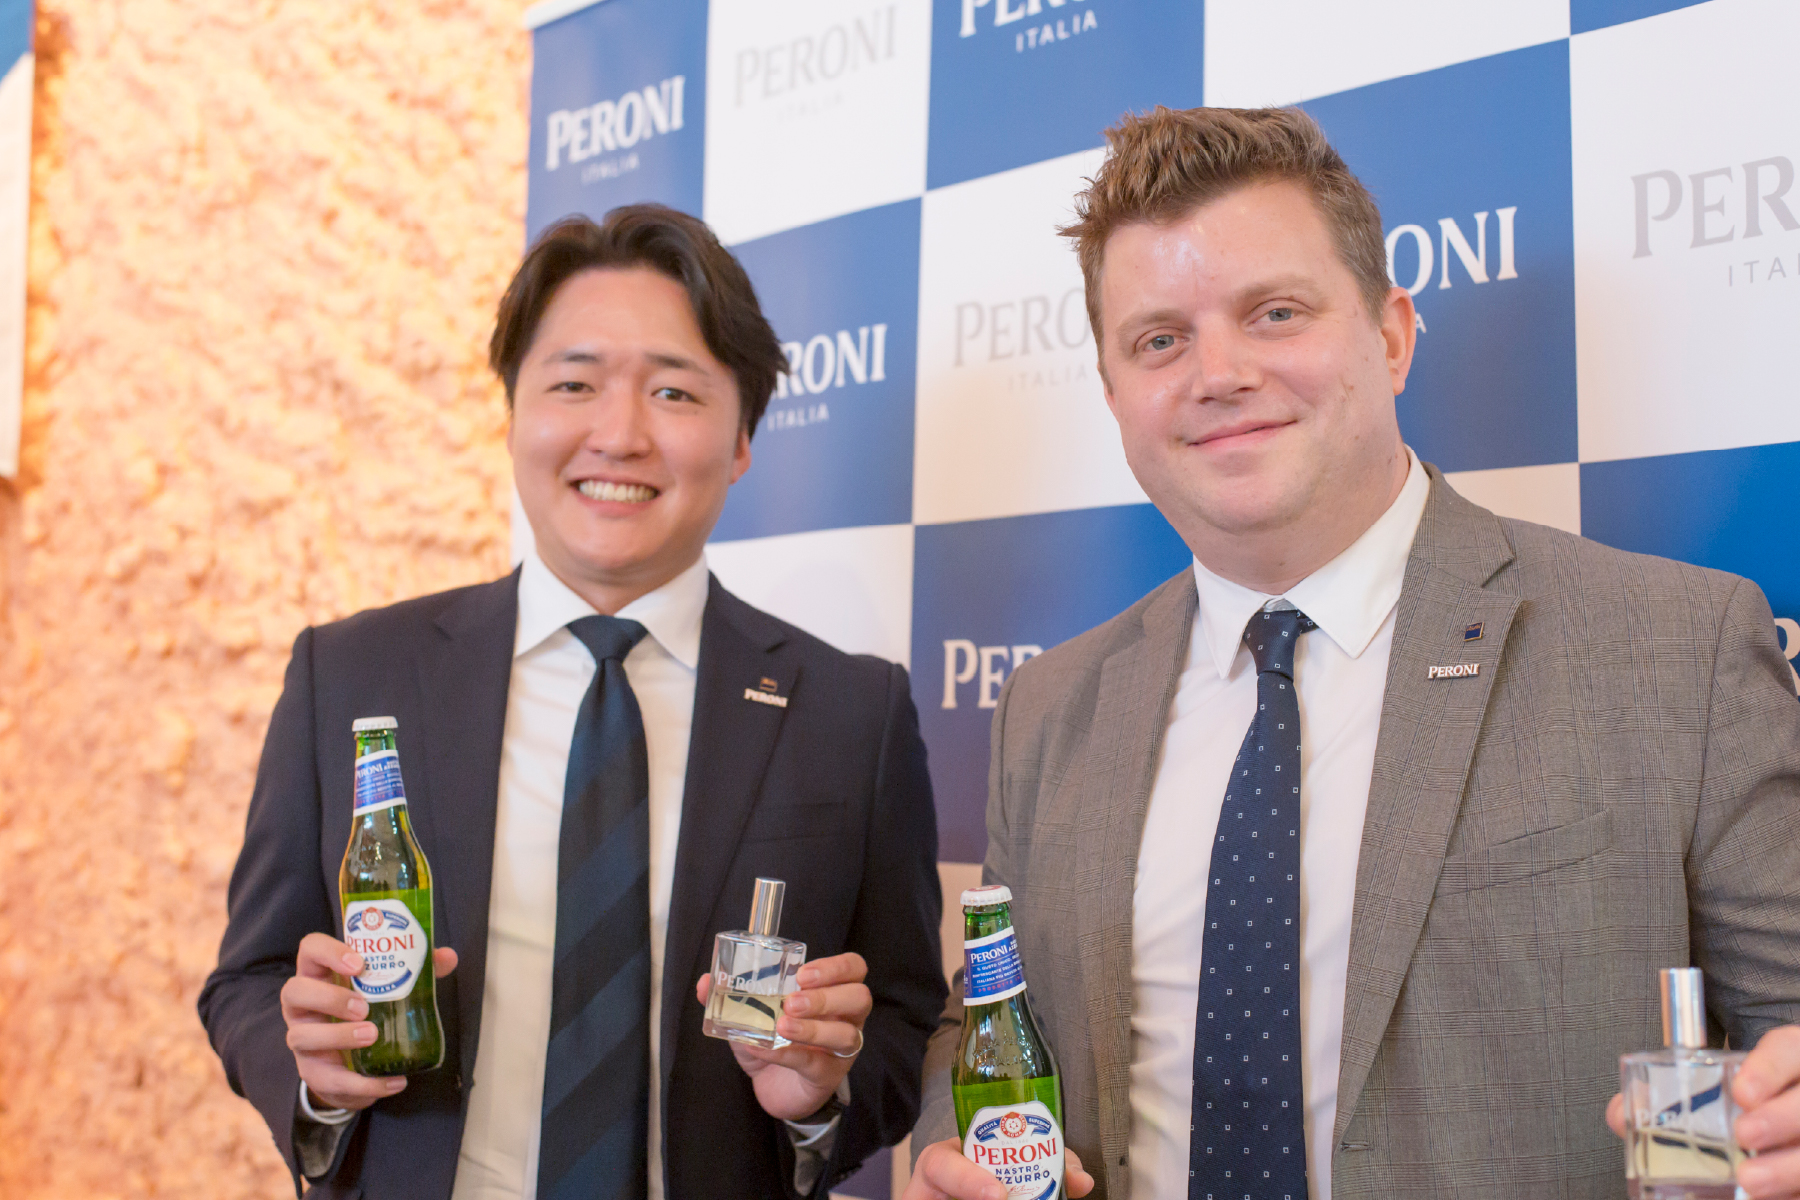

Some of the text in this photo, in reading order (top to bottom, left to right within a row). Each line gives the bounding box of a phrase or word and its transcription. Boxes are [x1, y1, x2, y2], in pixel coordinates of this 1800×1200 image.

[1015, 9, 1098, 53] ITALIA
[733, 5, 896, 109] PERONI
[546, 75, 686, 171] PERONI
[1630, 155, 1800, 259] PER
[953, 287, 1092, 368] PERO
[771, 323, 888, 400] RONI
[1427, 664, 1480, 680] PERONI
[364, 954, 395, 963] ASTRO
[365, 960, 406, 971] ZURRO
[970, 944, 1008, 964] PERONI
[973, 1137, 1058, 1166] PERONI
[995, 1164, 1040, 1176] NASTRO
